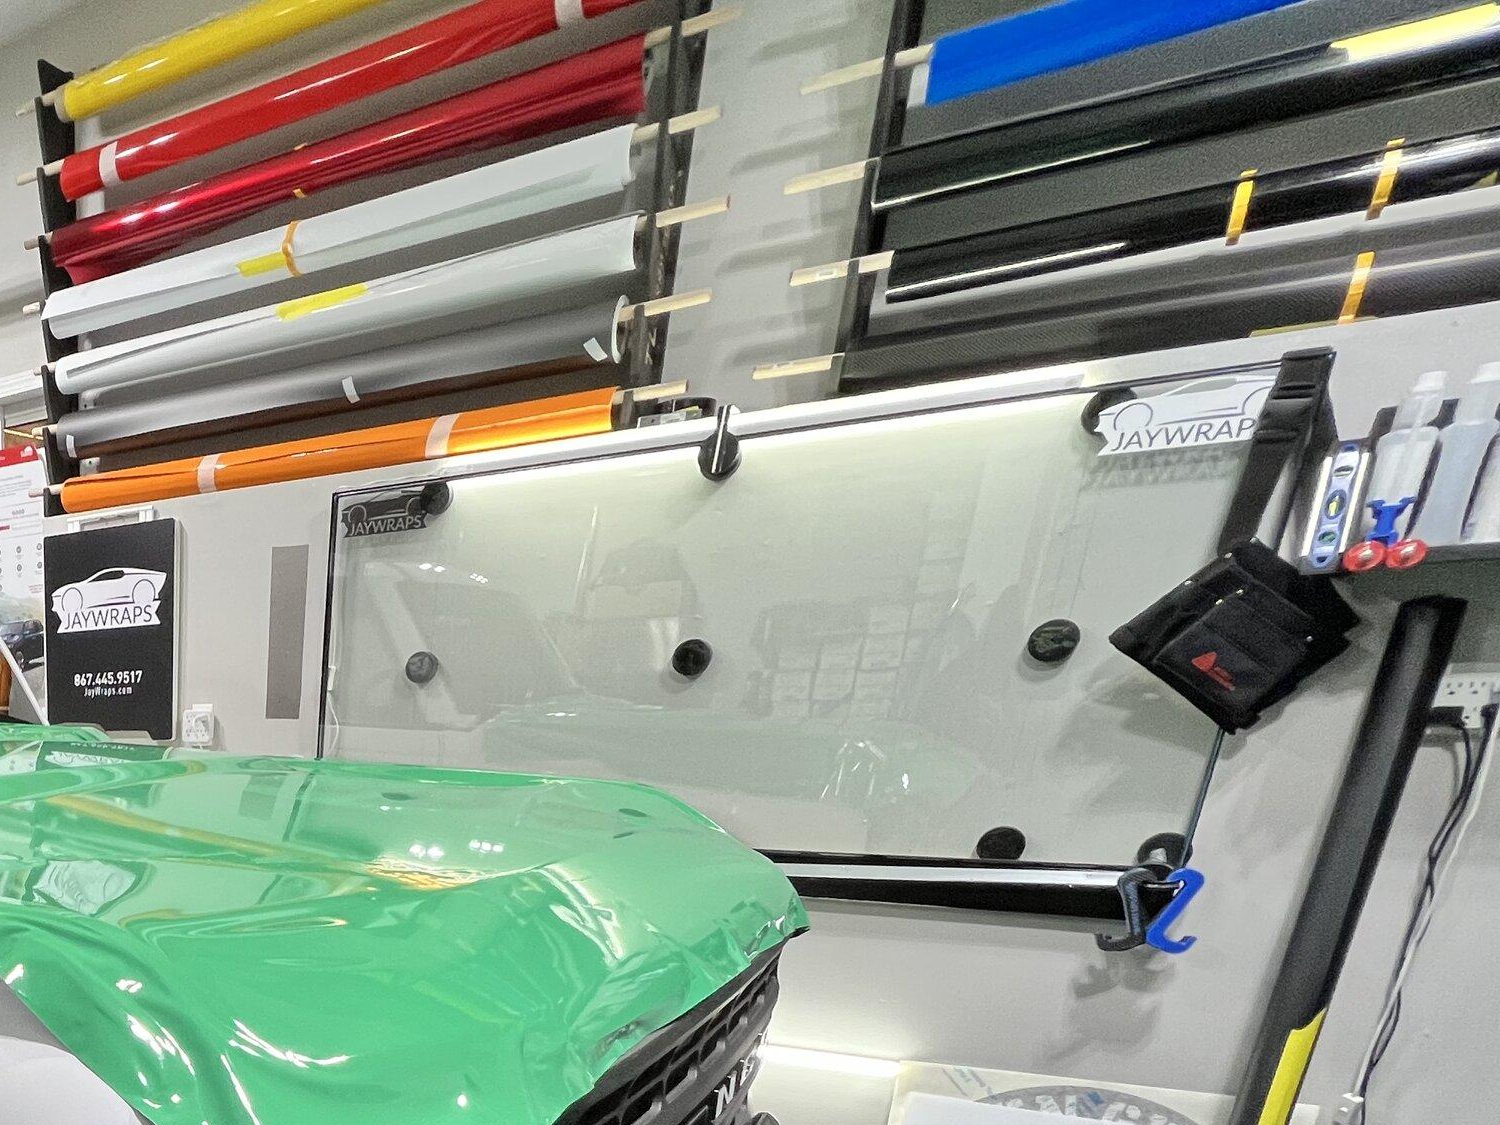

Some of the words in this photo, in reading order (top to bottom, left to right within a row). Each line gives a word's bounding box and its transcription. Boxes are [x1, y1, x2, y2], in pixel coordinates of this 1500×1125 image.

[1110, 417, 1257, 452] JAYWRAP
[349, 514, 422, 537] JAYWRAPS
[64, 604, 153, 630] JAYWRAPS
[73, 670, 143, 687] 867.445.9517
[83, 687, 133, 698] JayWraps.com
